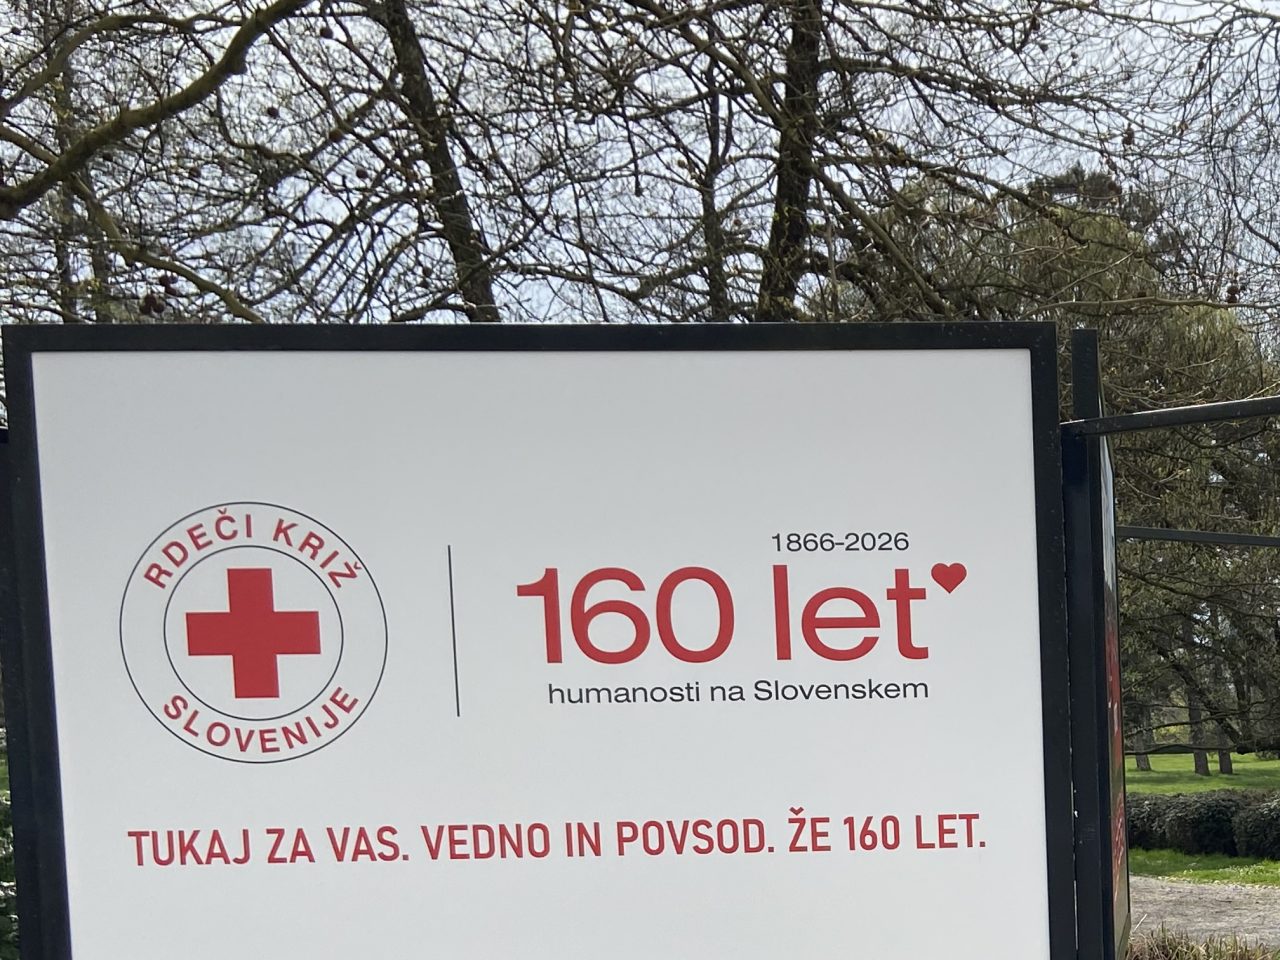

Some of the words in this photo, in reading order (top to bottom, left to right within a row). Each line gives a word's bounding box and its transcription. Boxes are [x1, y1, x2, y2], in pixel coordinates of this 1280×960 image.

[143, 508, 255, 590] RDEČI
[271, 518, 363, 589] KRIŽ
[772, 532, 909, 551] 1866-2026
[515, 566, 735, 665] 160
[772, 564, 928, 662] let
[162, 686, 359, 754] SLOVENIJE
[549, 682, 699, 703] humanosti
[711, 686, 745, 701] na
[754, 679, 928, 701] Slovenskem
[128, 828, 250, 867] TUKAJ
[265, 827, 315, 864] ZA
[326, 825, 409, 862] VAS.
[420, 822, 550, 861] VEDNO
[565, 821, 602, 857] IN
[616, 818, 775, 856] POVSOD.
[788, 807, 832, 853] ŽE
[843, 815, 900, 852] 160
[915, 813, 987, 849] LET.
